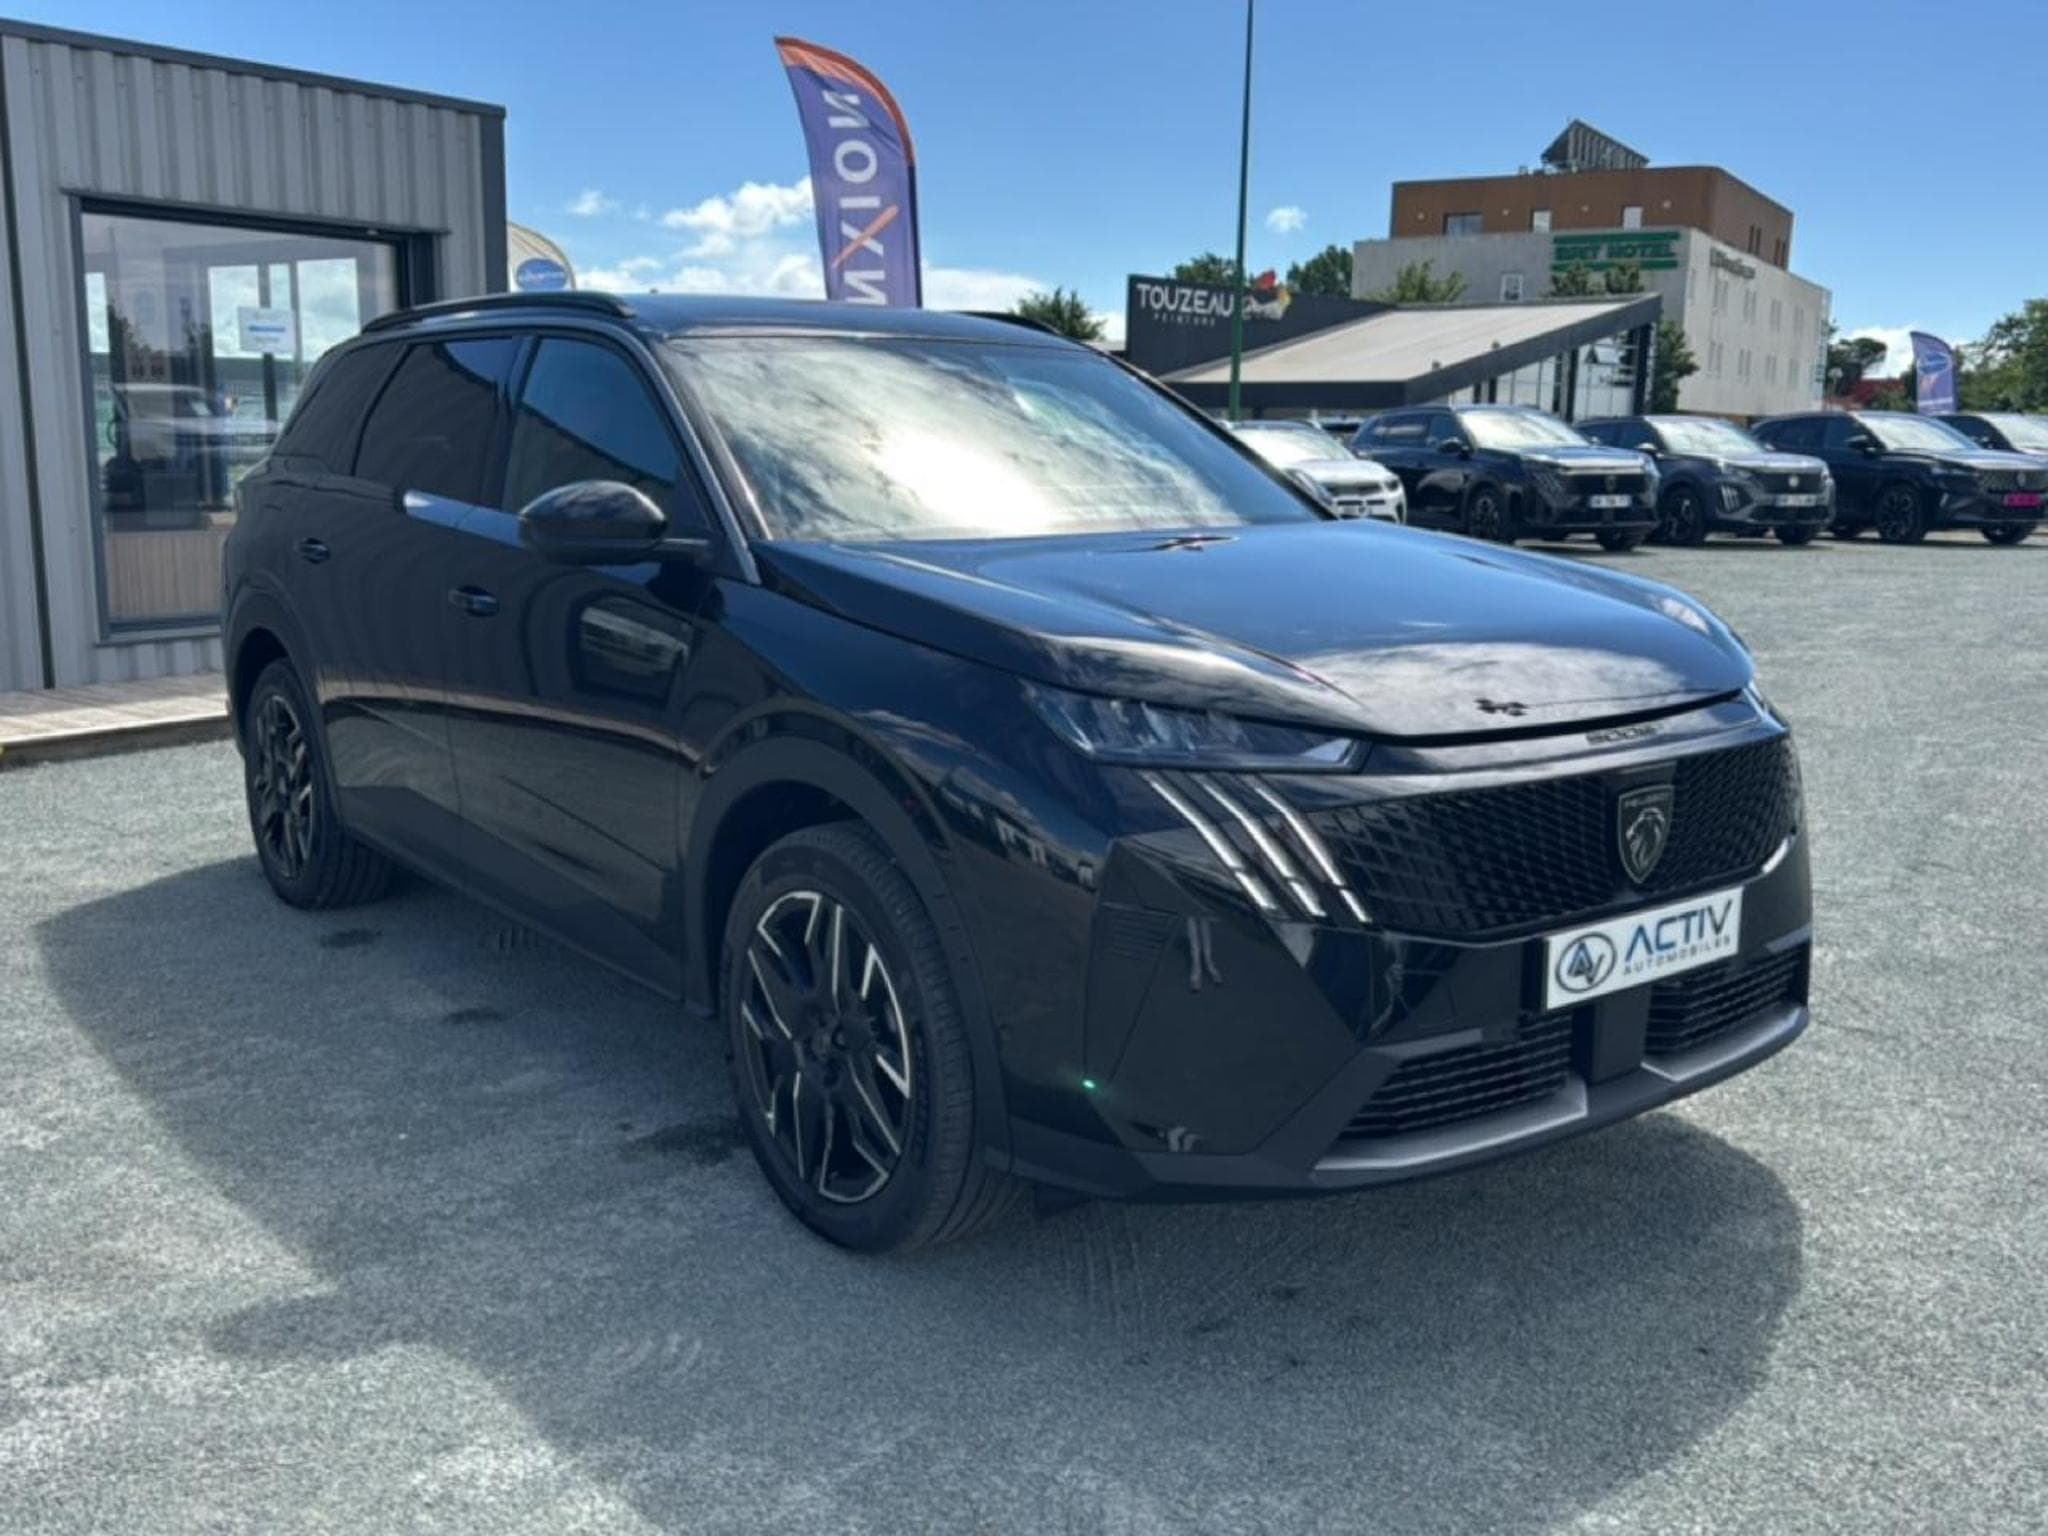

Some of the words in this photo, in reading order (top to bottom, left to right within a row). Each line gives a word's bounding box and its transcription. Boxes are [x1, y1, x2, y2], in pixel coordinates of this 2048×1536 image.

[1136, 283, 1235, 318] TOUZEAU
[1625, 899, 1733, 962] ACTIV
[1623, 934, 1732, 976] AUTOMOBILES
